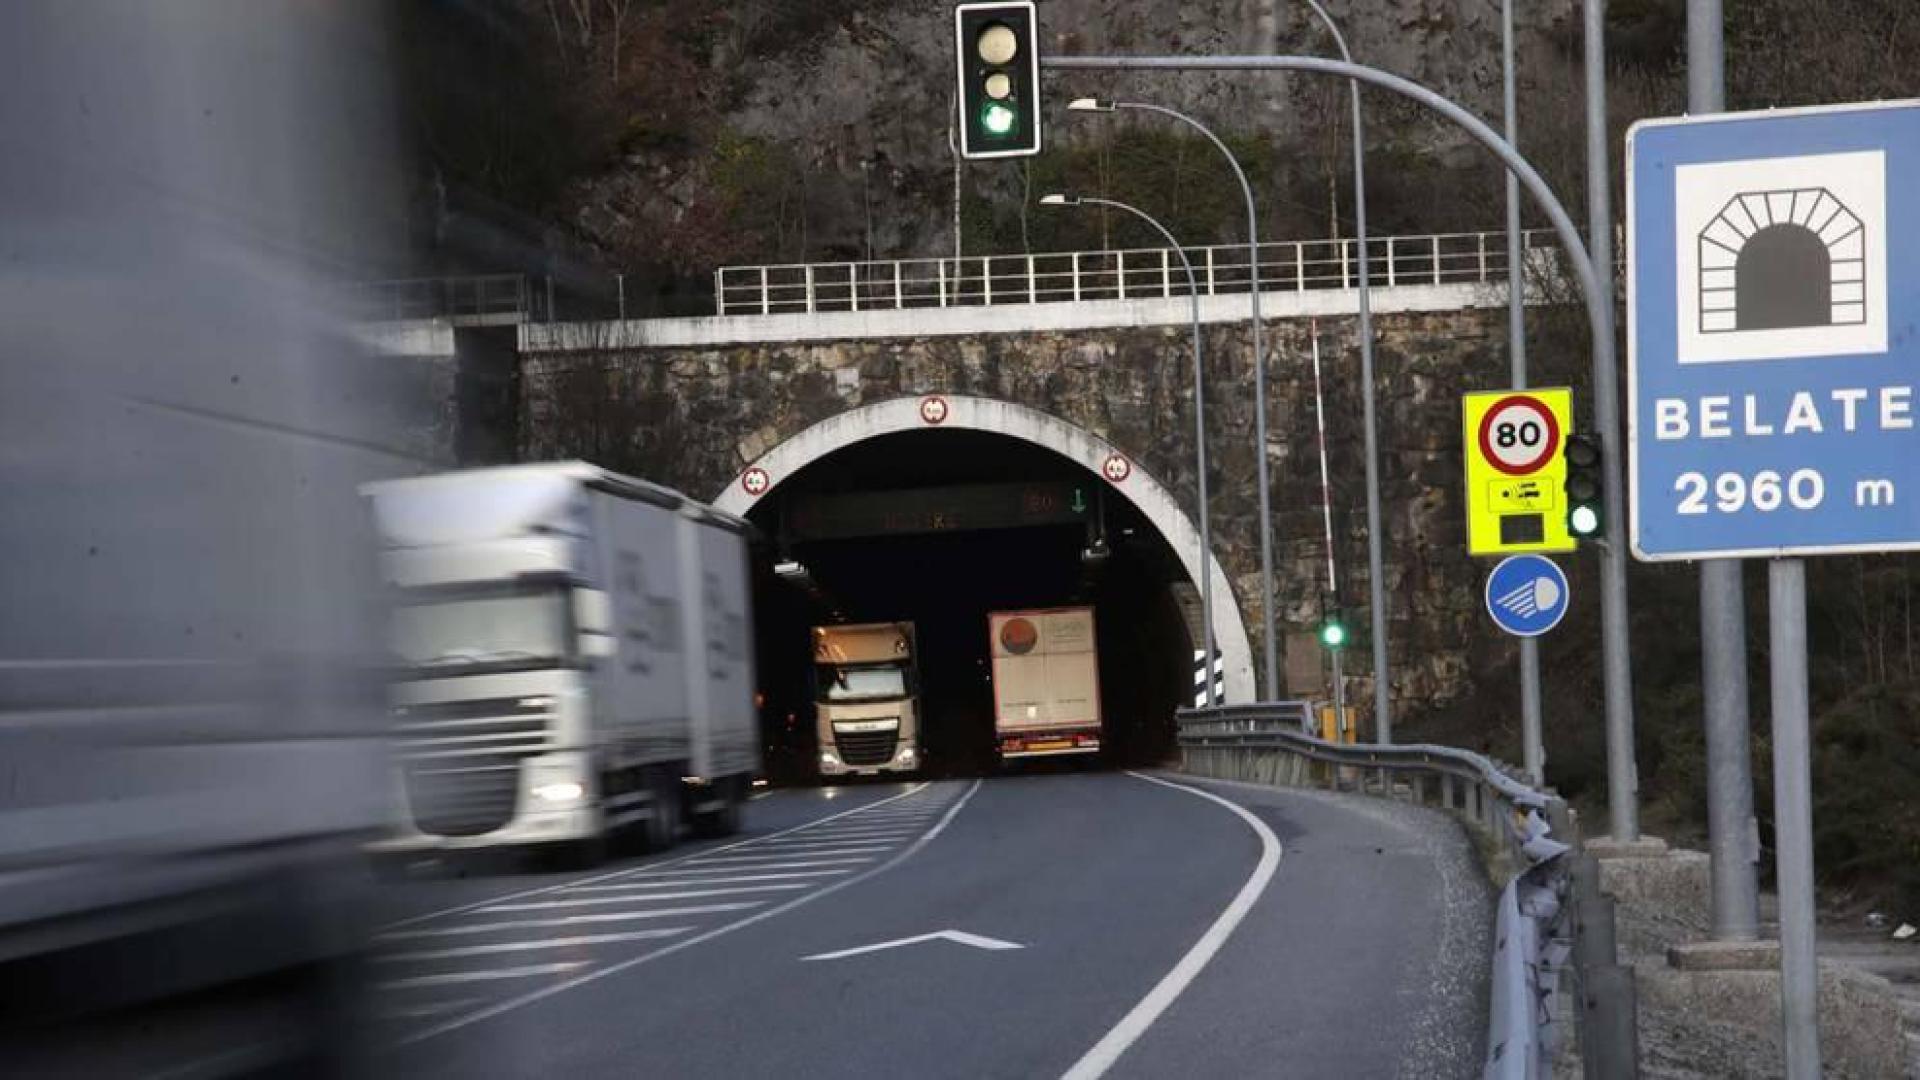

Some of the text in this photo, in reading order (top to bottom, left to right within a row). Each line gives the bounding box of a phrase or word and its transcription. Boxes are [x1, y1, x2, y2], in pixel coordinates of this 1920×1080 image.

[1496, 422, 1541, 448] 80
[1655, 386, 1913, 440] BELATE
[1674, 469, 1895, 515] 2960 m
